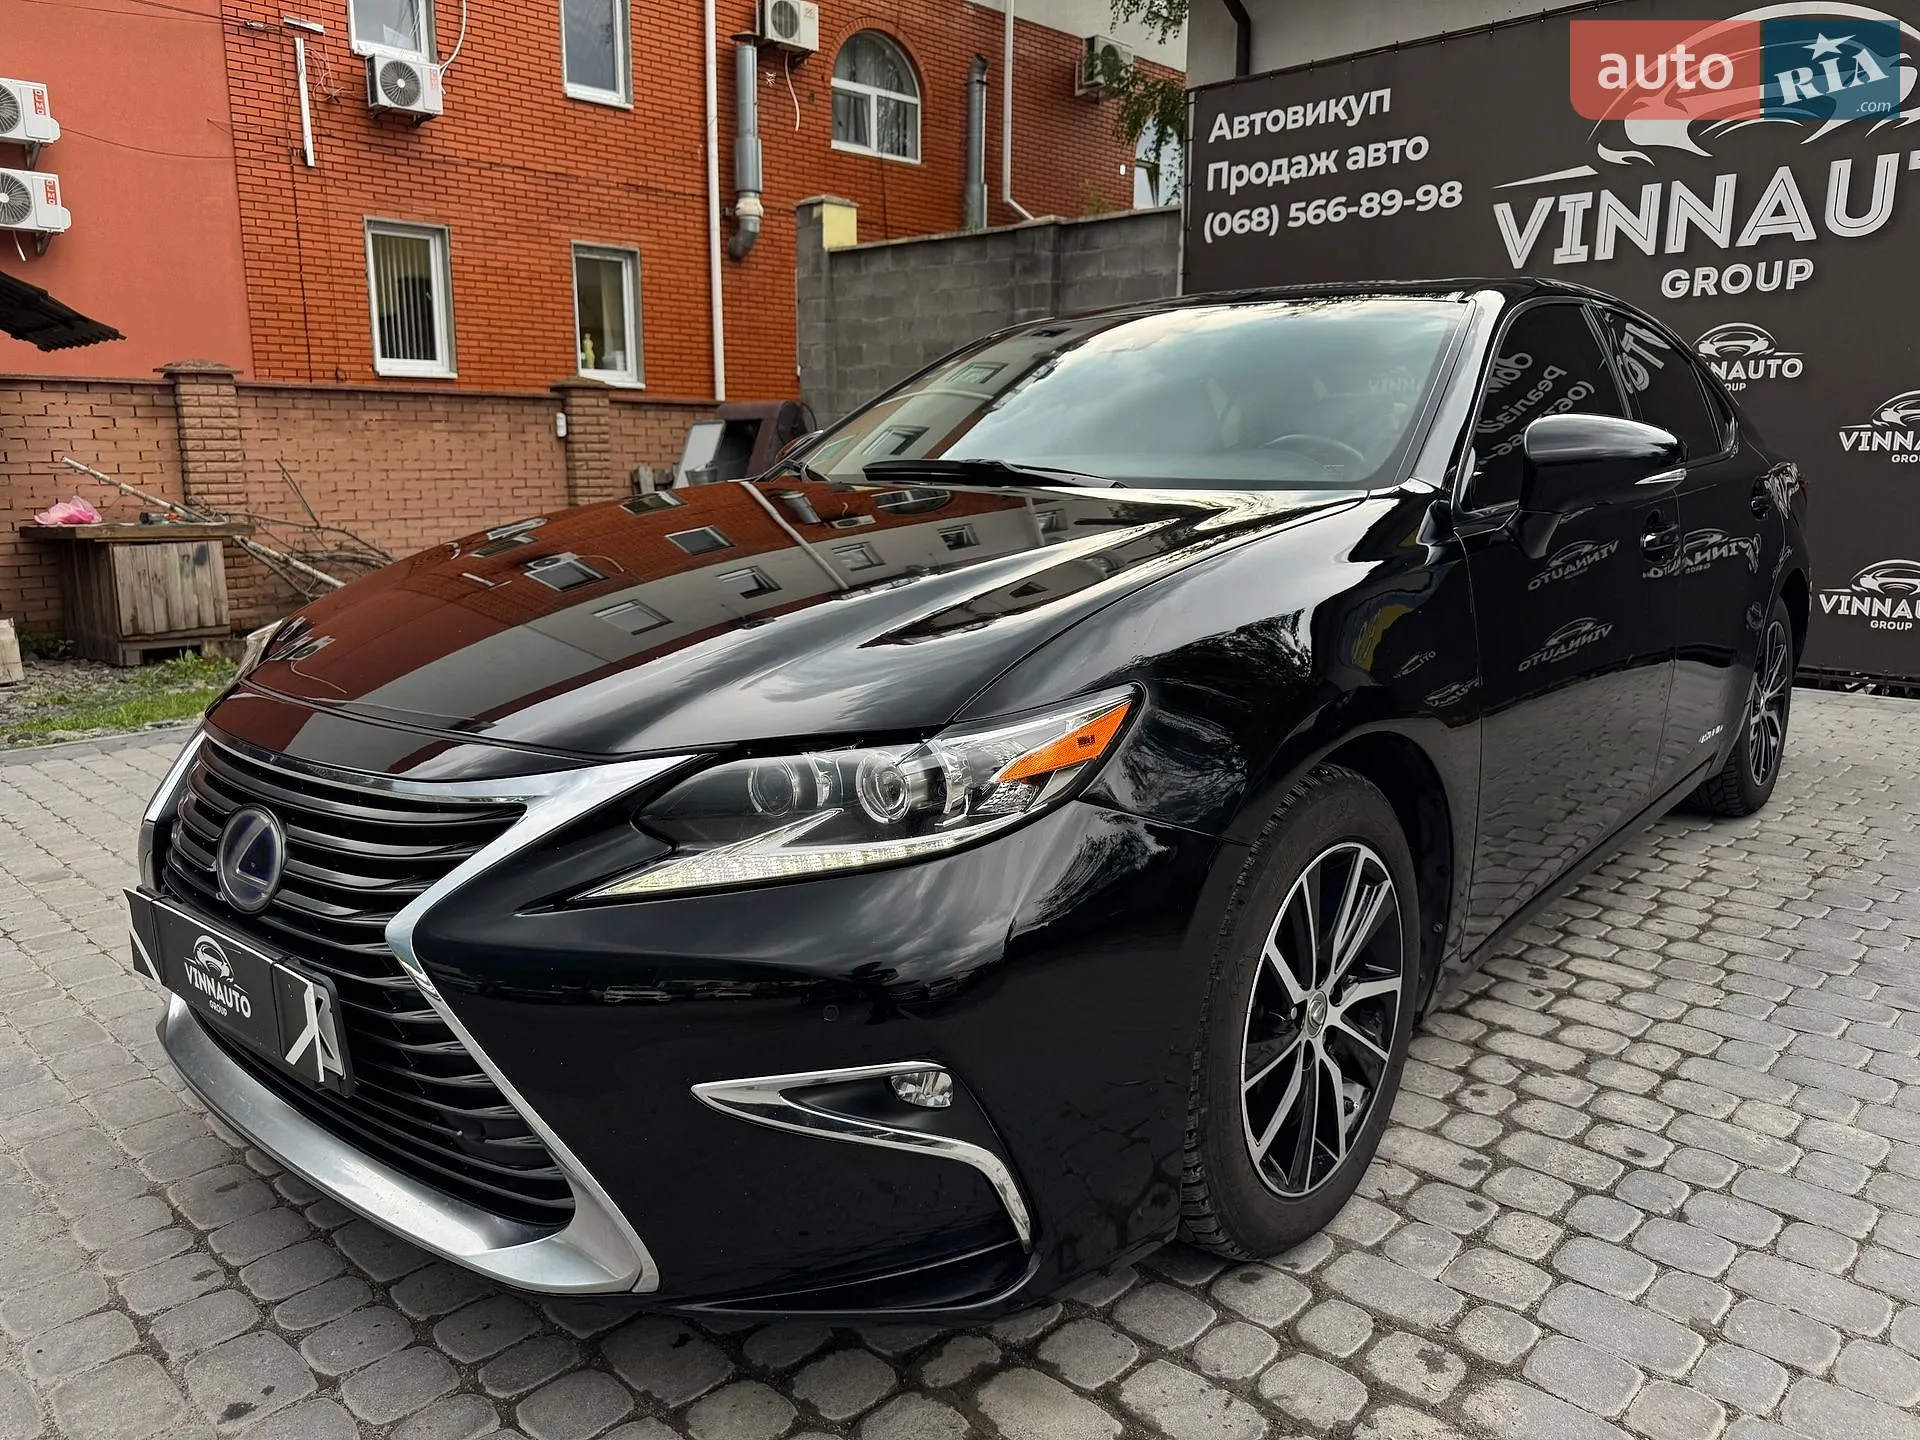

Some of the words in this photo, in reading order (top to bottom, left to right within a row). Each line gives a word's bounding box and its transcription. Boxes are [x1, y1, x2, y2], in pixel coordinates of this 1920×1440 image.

[1208, 88, 1391, 143] Автовикуп
[1207, 149, 1339, 195] Продаж
[1346, 136, 1429, 170] авто
[1204, 205, 1279, 243] (068)
[1287, 181, 1463, 227] 566-89-98
[1661, 258, 1814, 298] GROUP
[1706, 358, 1803, 380] NAUTO
[1725, 382, 1747, 391] OUP
[1891, 454, 1920, 463] GRO
[1870, 620, 1913, 631] GROUP
[184, 961, 251, 1018] VINNAUTO
